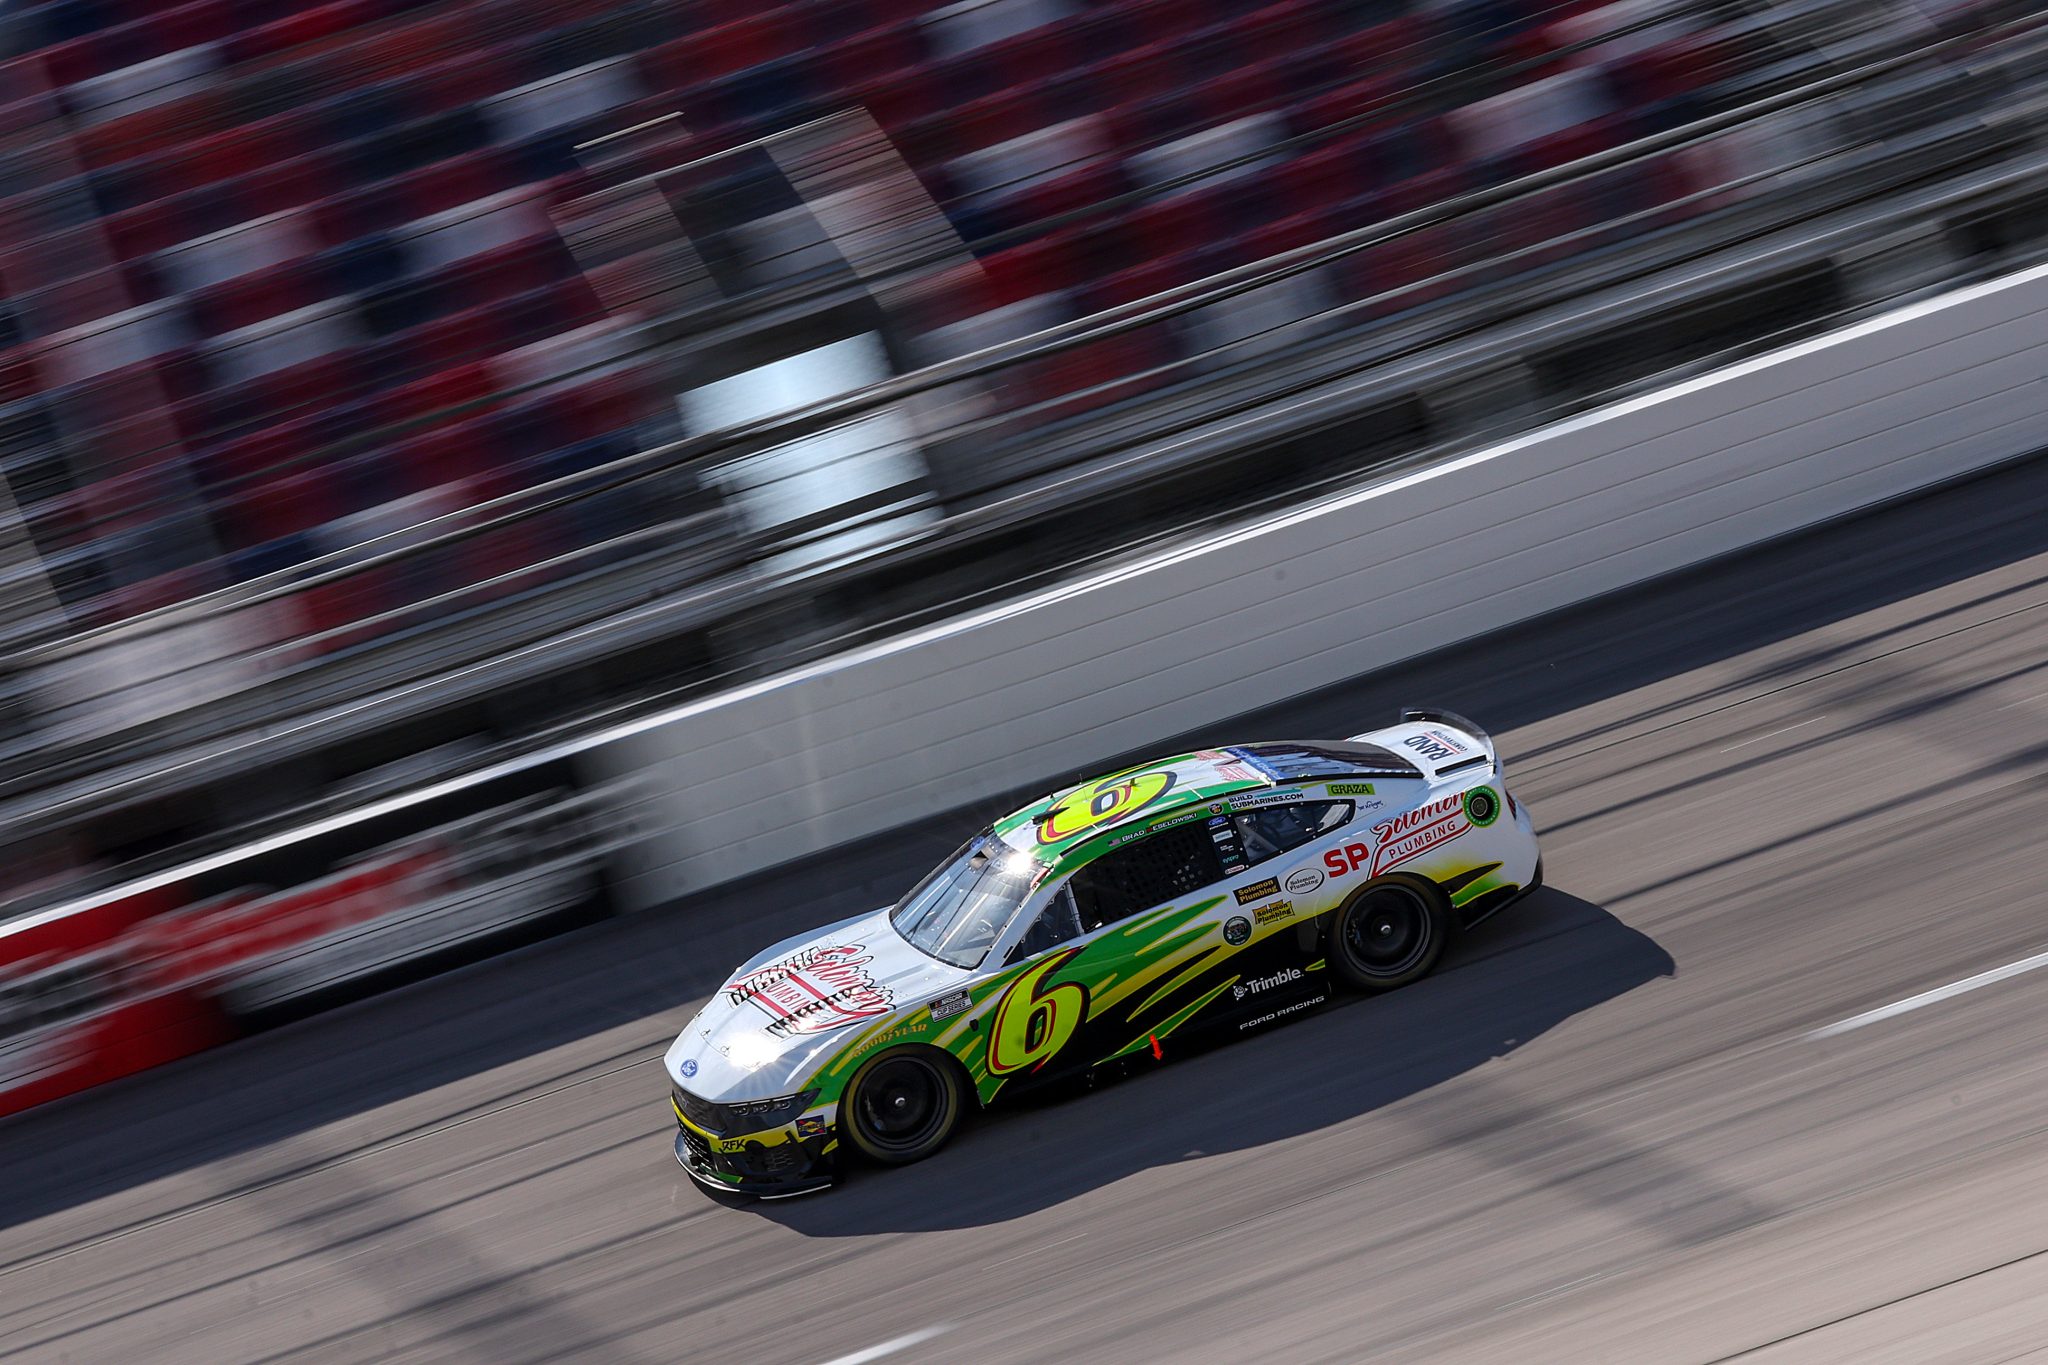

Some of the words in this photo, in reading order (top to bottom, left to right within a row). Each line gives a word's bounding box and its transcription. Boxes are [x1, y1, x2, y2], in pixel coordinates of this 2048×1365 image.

[1403, 735, 1455, 761] RAND
[1229, 794, 1254, 803] BUILD
[1231, 793, 1304, 809] SUBMARINES.COM
[1330, 784, 1371, 795] GRAZA
[1036, 771, 1178, 846] 6
[1122, 830, 1145, 842] BRAD
[1146, 813, 1197, 833] ESELOWSKI
[1388, 820, 1457, 859] PLUMBING
[1323, 842, 1370, 878] SP
[1238, 880, 1274, 896] Solomon
[1239, 885, 1278, 903] Plumbing
[1246, 968, 1301, 994] Trimble
[985, 945, 1091, 1080] 6
[1239, 1013, 1276, 1030] FORD
[1277, 995, 1325, 1017] RACING
[853, 1023, 928, 1058] GOODYEAR
[722, 1138, 745, 1151] RFK
